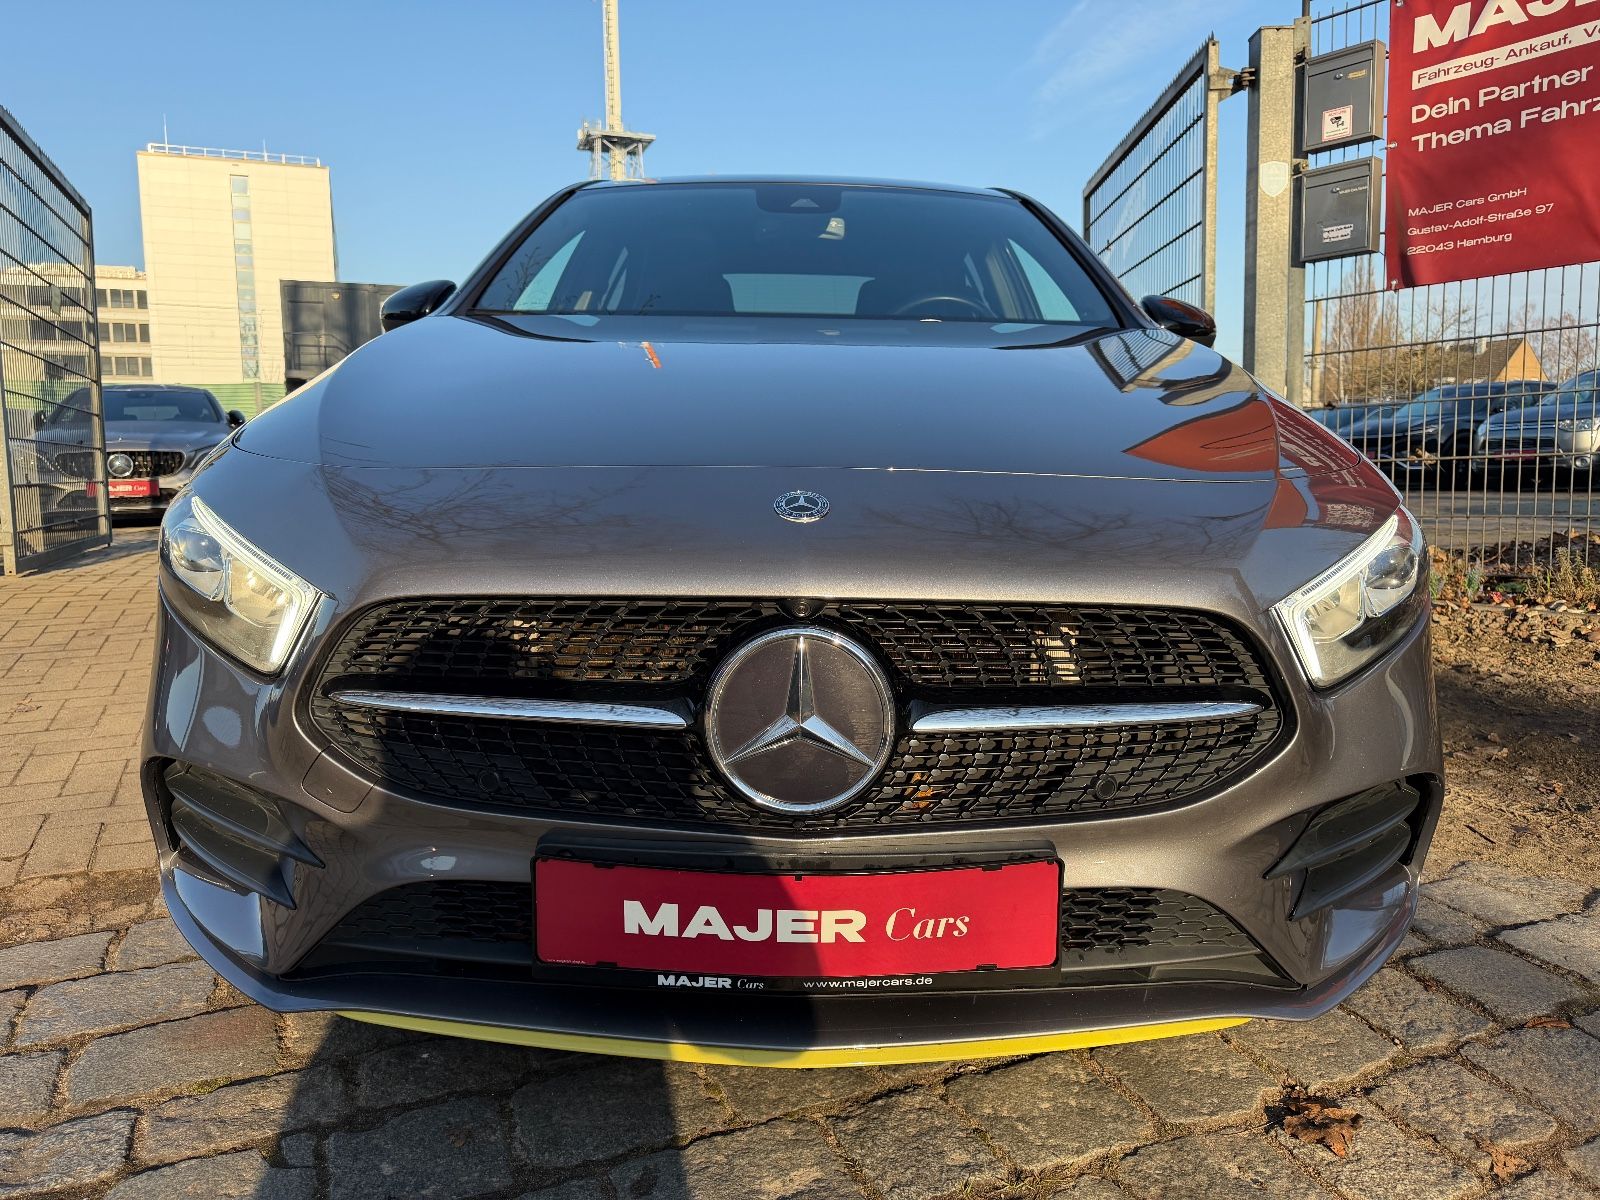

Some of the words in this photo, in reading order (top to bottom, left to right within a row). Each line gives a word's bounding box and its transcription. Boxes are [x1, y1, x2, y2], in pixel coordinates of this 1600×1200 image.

[1418, 56, 1500, 84] Fahrzeug-
[1505, 34, 1572, 60] Ankauf,
[1584, 25, 1600, 37] V
[1412, 97, 1470, 123] Dein
[1479, 65, 1593, 107] Partner
[1412, 118, 1511, 152] Thema
[1408, 202, 1453, 217] MAJER
[1456, 197, 1484, 208] Cars
[1488, 188, 1527, 202] GmbH
[1408, 209, 1531, 236] Gustav-Adolf-Straße
[1535, 203, 1554, 213] 97
[1407, 242, 1453, 255] 22043
[1457, 233, 1512, 248] Hamburg
[624, 900, 867, 943] MAJER
[885, 907, 970, 941] Cars
[657, 974, 732, 989] MAJER
[737, 978, 765, 990] Cars
[803, 975, 933, 989] www.majercars.de
